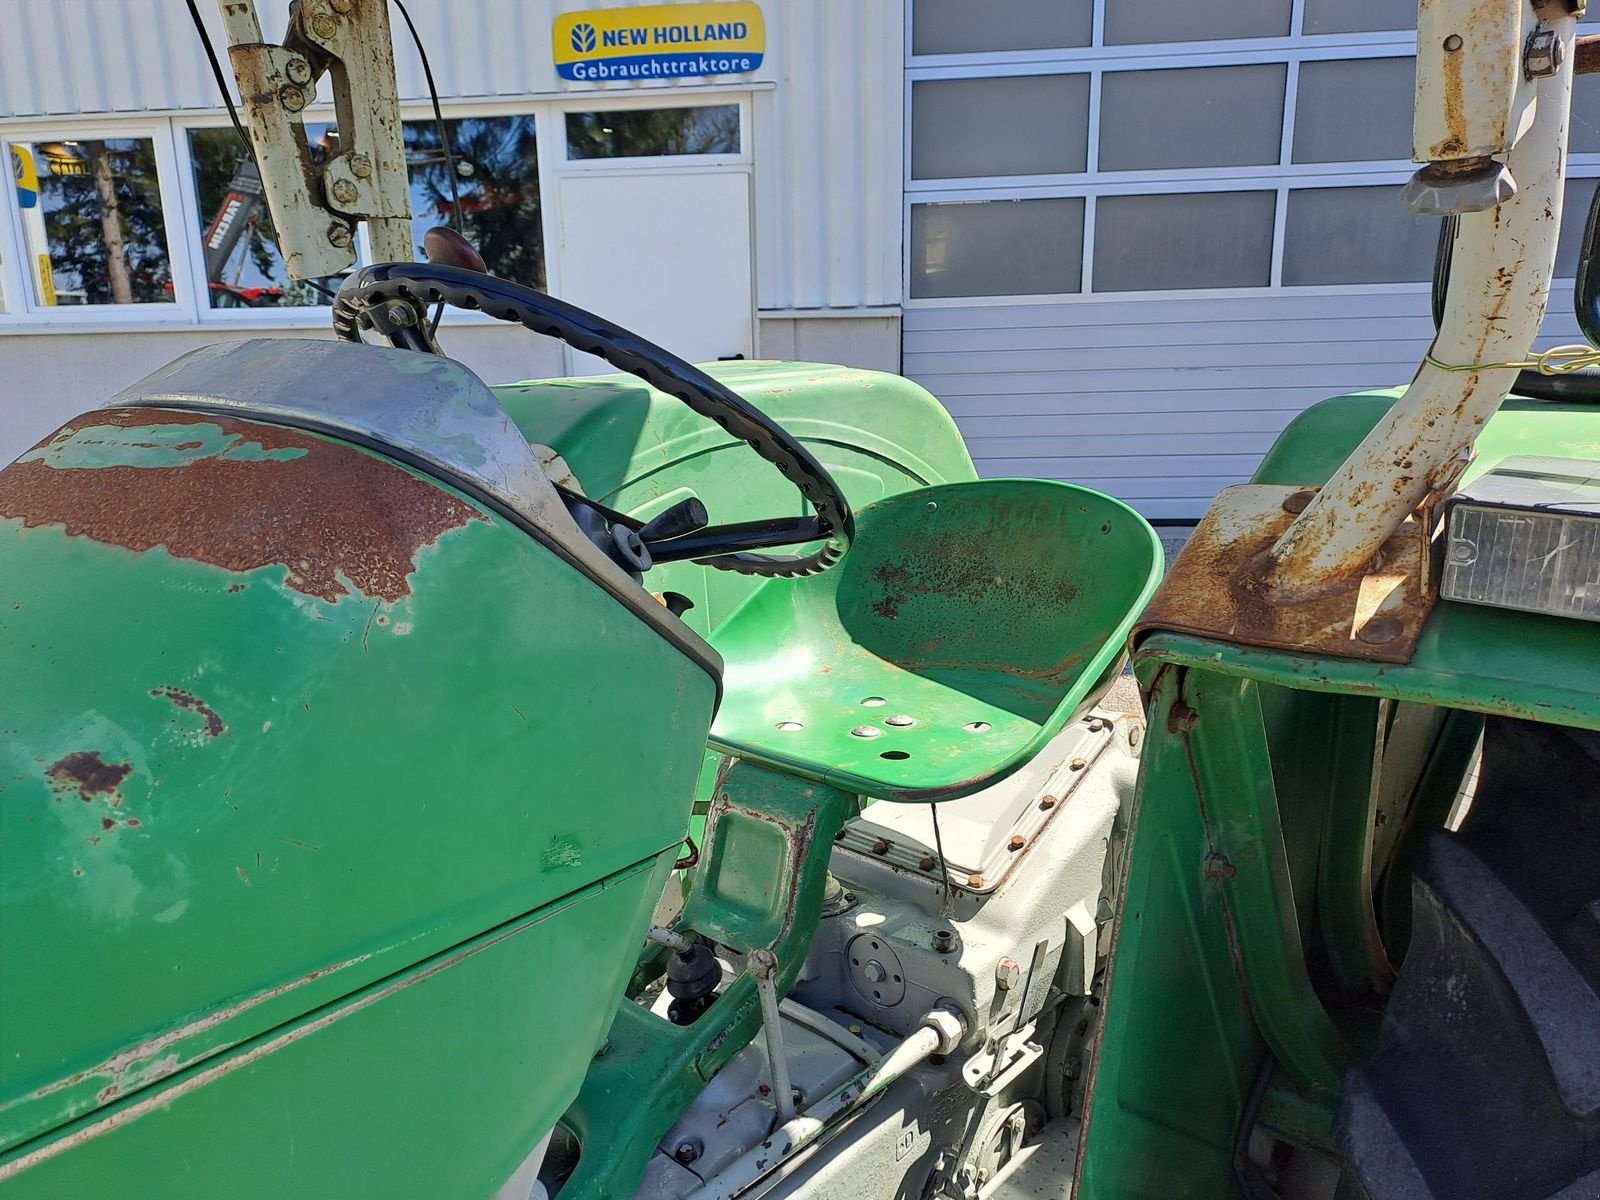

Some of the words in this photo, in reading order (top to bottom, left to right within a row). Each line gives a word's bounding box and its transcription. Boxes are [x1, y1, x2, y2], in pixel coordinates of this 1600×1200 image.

[602, 28, 648, 47] NEW
[654, 22, 747, 44] HOLLAND
[572, 57, 750, 79] Gebrauchttraktore
